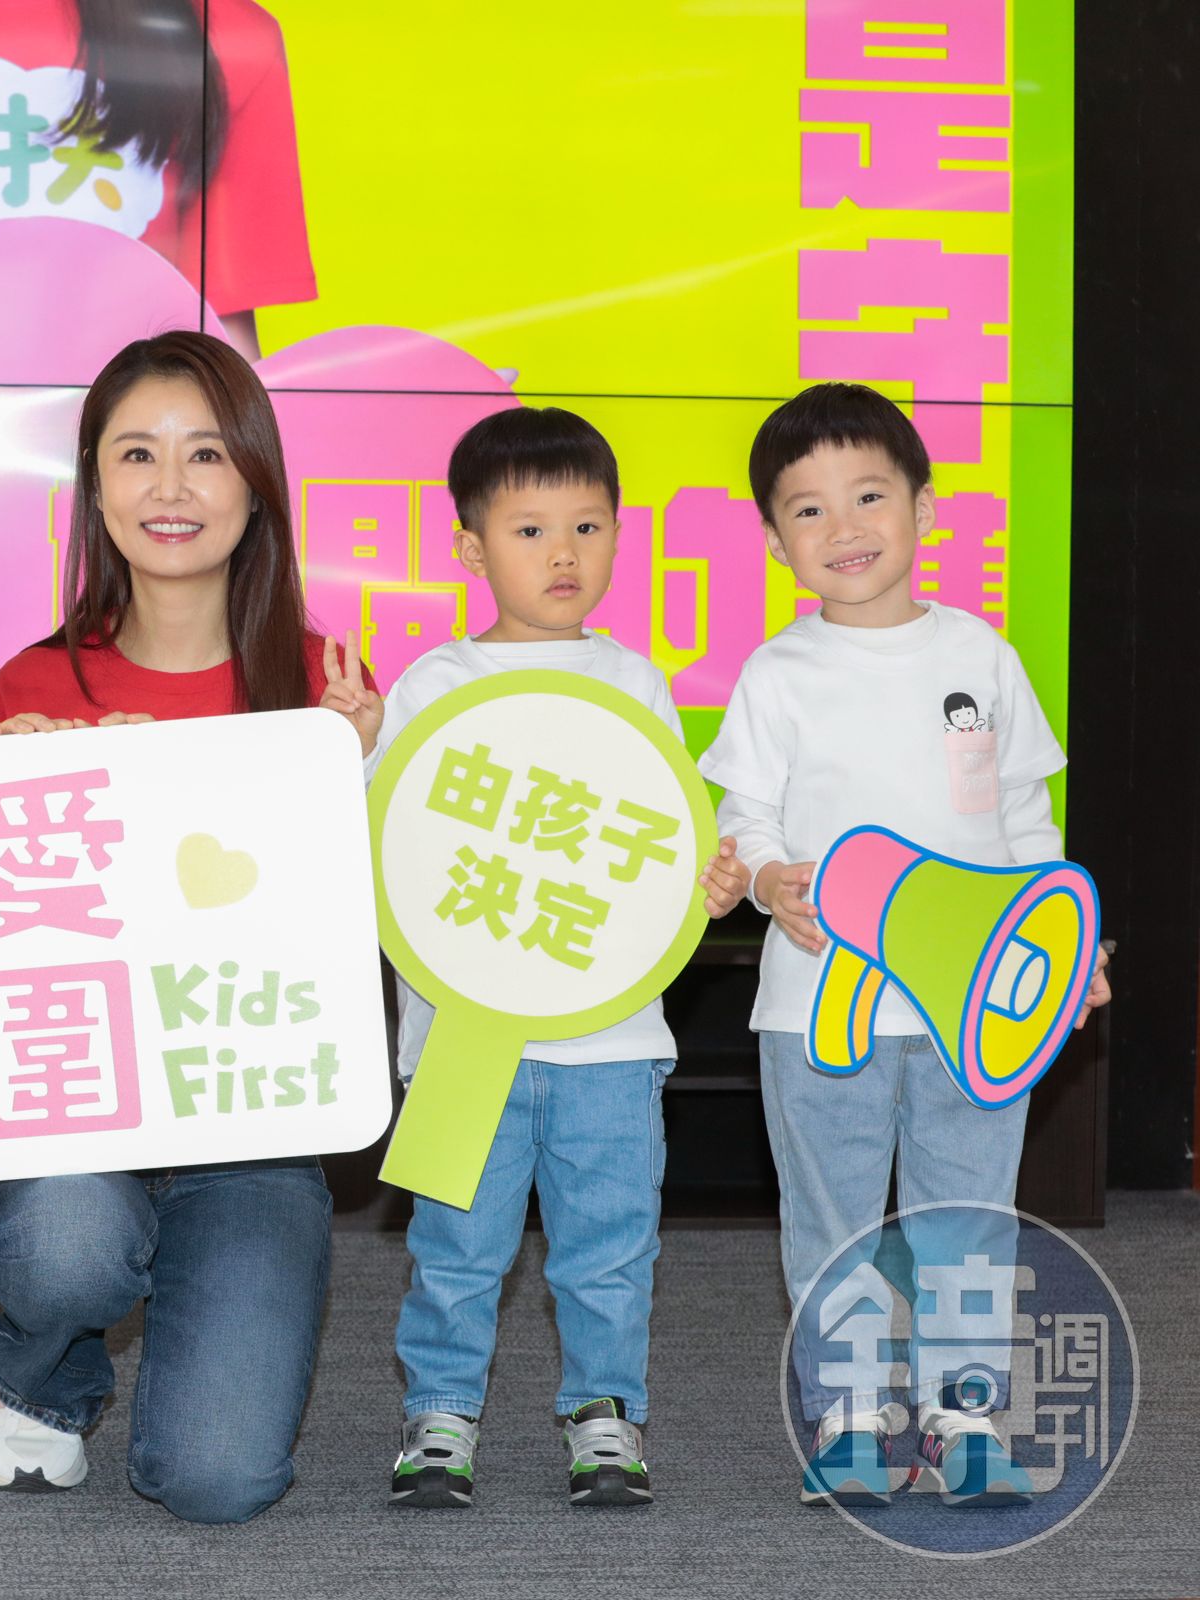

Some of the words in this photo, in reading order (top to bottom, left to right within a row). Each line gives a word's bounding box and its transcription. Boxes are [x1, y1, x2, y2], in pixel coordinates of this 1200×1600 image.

[425, 743, 681, 883] 由孩子
[433, 844, 612, 972] 決定
[150, 960, 323, 1031] Kids
[161, 1042, 341, 1118] First
